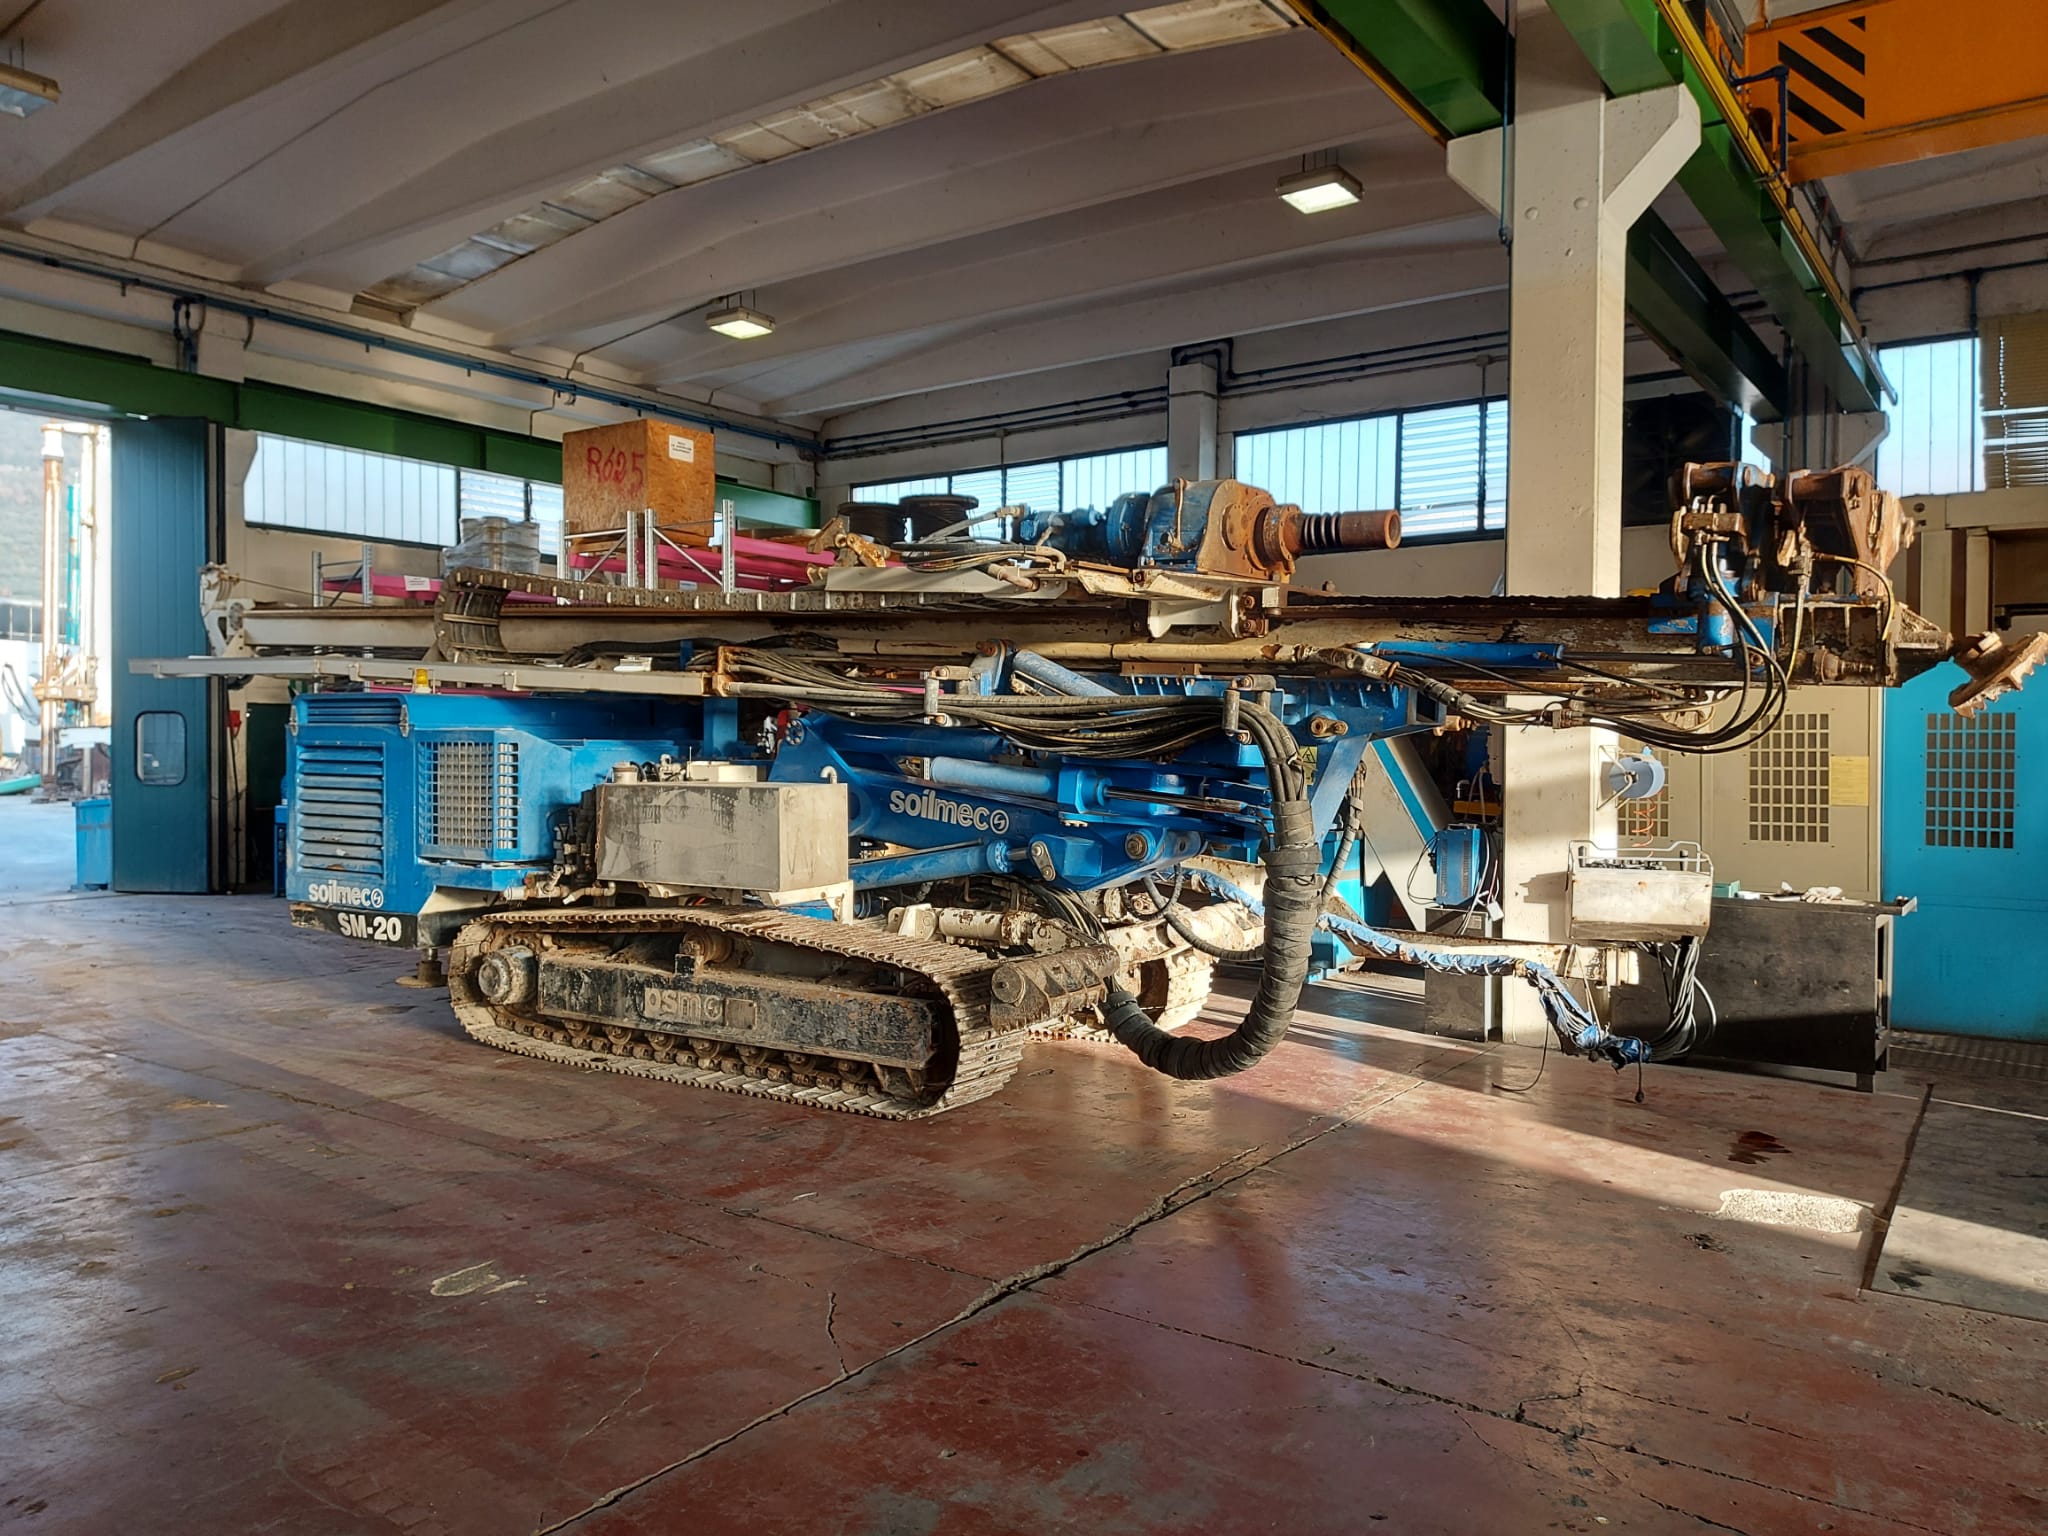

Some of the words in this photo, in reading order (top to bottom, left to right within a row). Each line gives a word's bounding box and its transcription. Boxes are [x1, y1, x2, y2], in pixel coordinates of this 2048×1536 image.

[889, 788, 990, 831] soilmec
[308, 879, 371, 907] soilmec
[337, 912, 402, 942] SM-20
